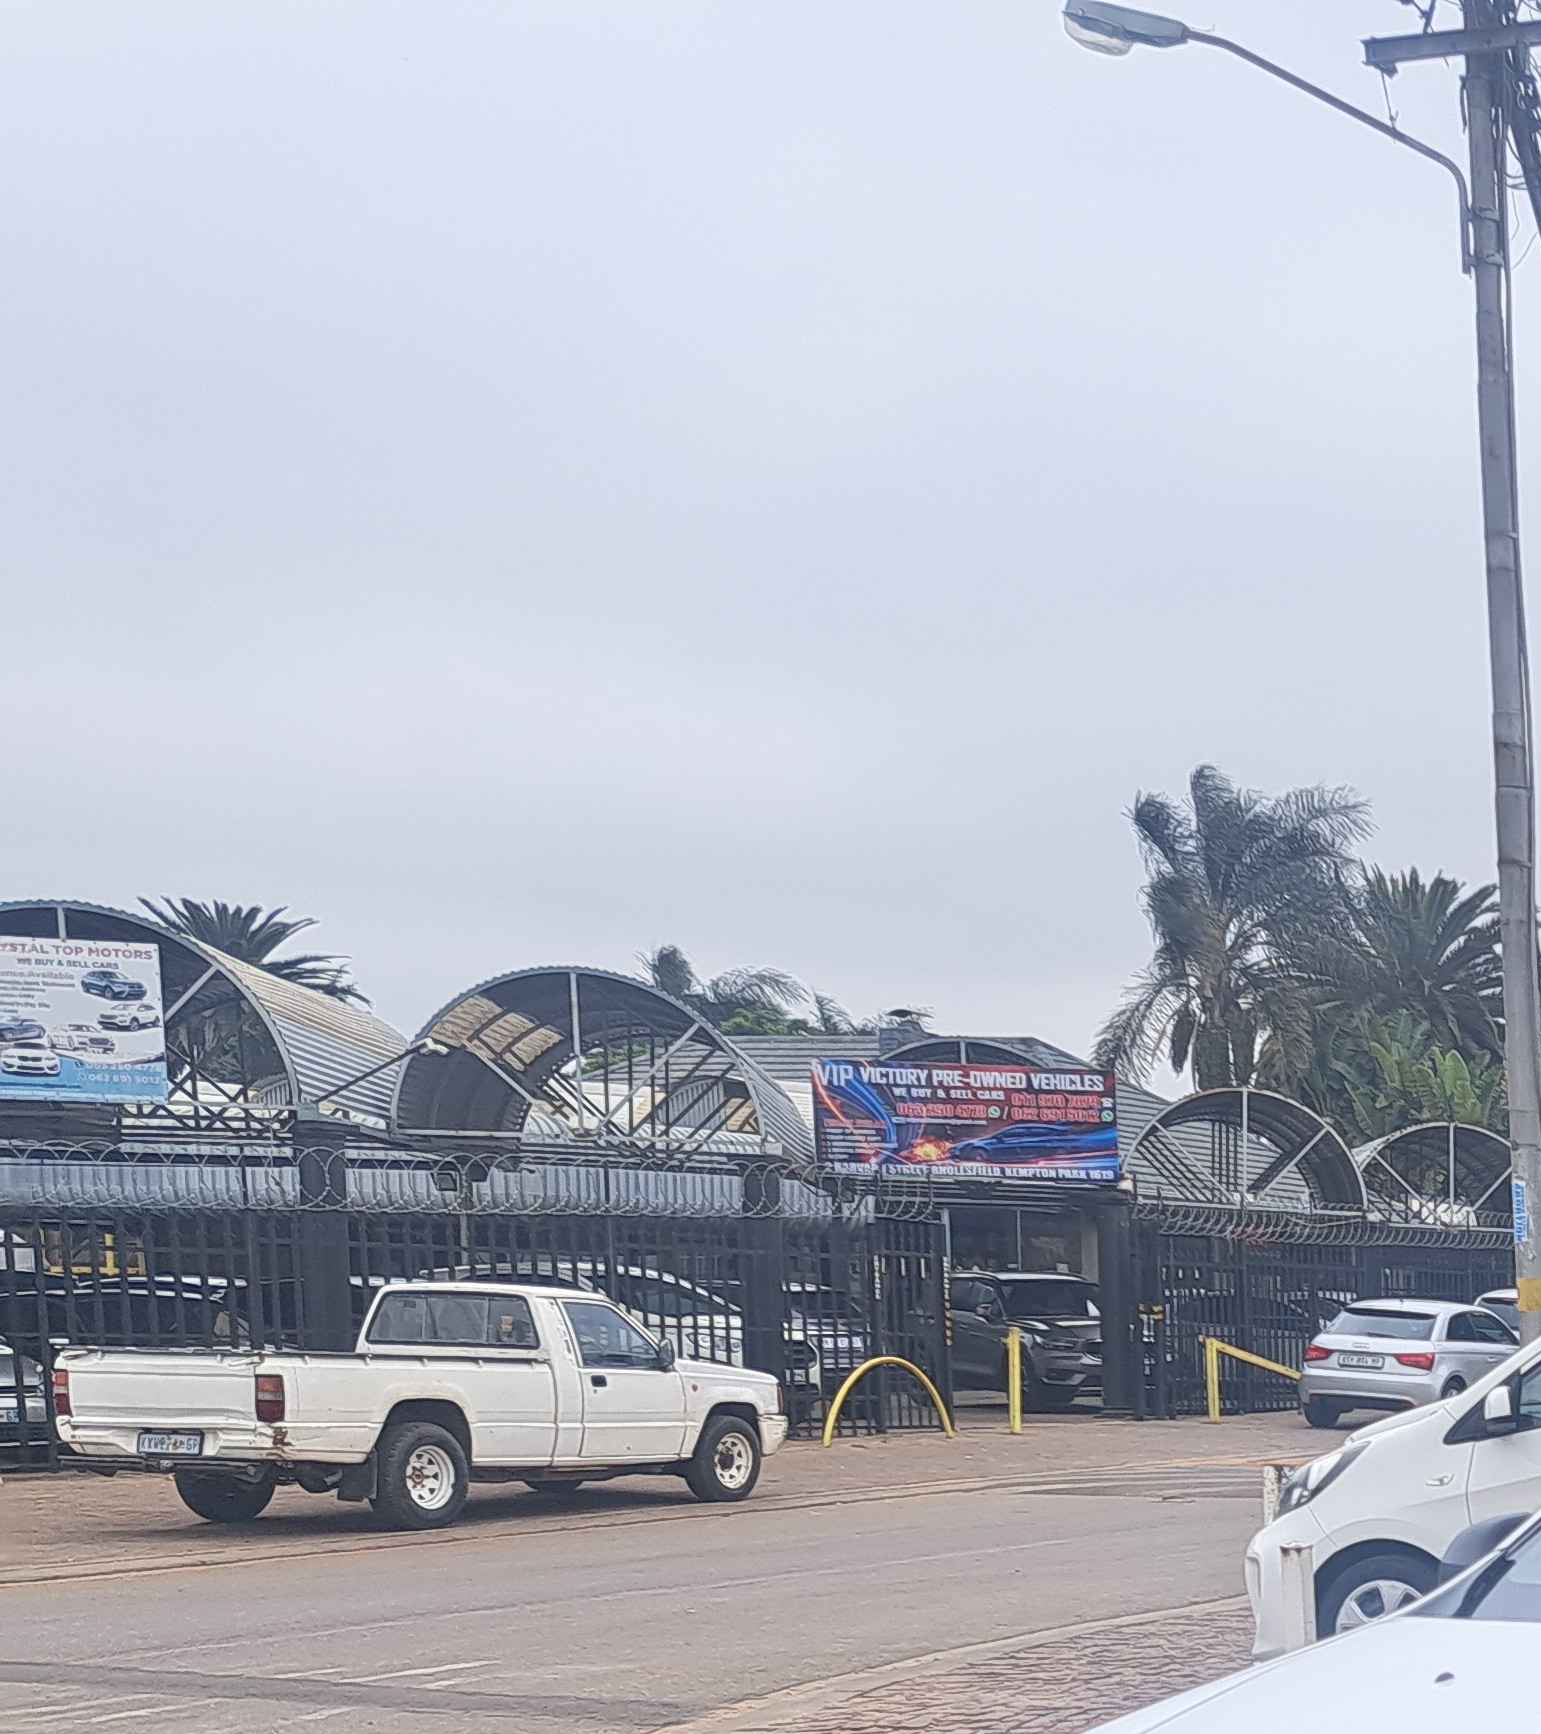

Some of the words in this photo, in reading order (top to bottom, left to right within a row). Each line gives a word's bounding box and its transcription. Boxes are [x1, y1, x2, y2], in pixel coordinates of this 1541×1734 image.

[53, 945, 85, 957] TOP
[88, 947, 153, 960] MOTORS
[35, 958, 54, 967] BUY
[66, 960, 90, 969] SELL
[92, 961, 120, 970] CARS
[817, 1064, 853, 1086] VIP
[860, 1067, 928, 1085] VICTORY
[931, 1069, 1026, 1089] PRE-OWNED
[1030, 1072, 1105, 1091] VEHICLES
[892, 1087, 907, 1097] WE
[911, 1087, 932, 1098] BUY
[951, 1089, 973, 1099] SELL
[977, 1090, 1005, 1100] CARS
